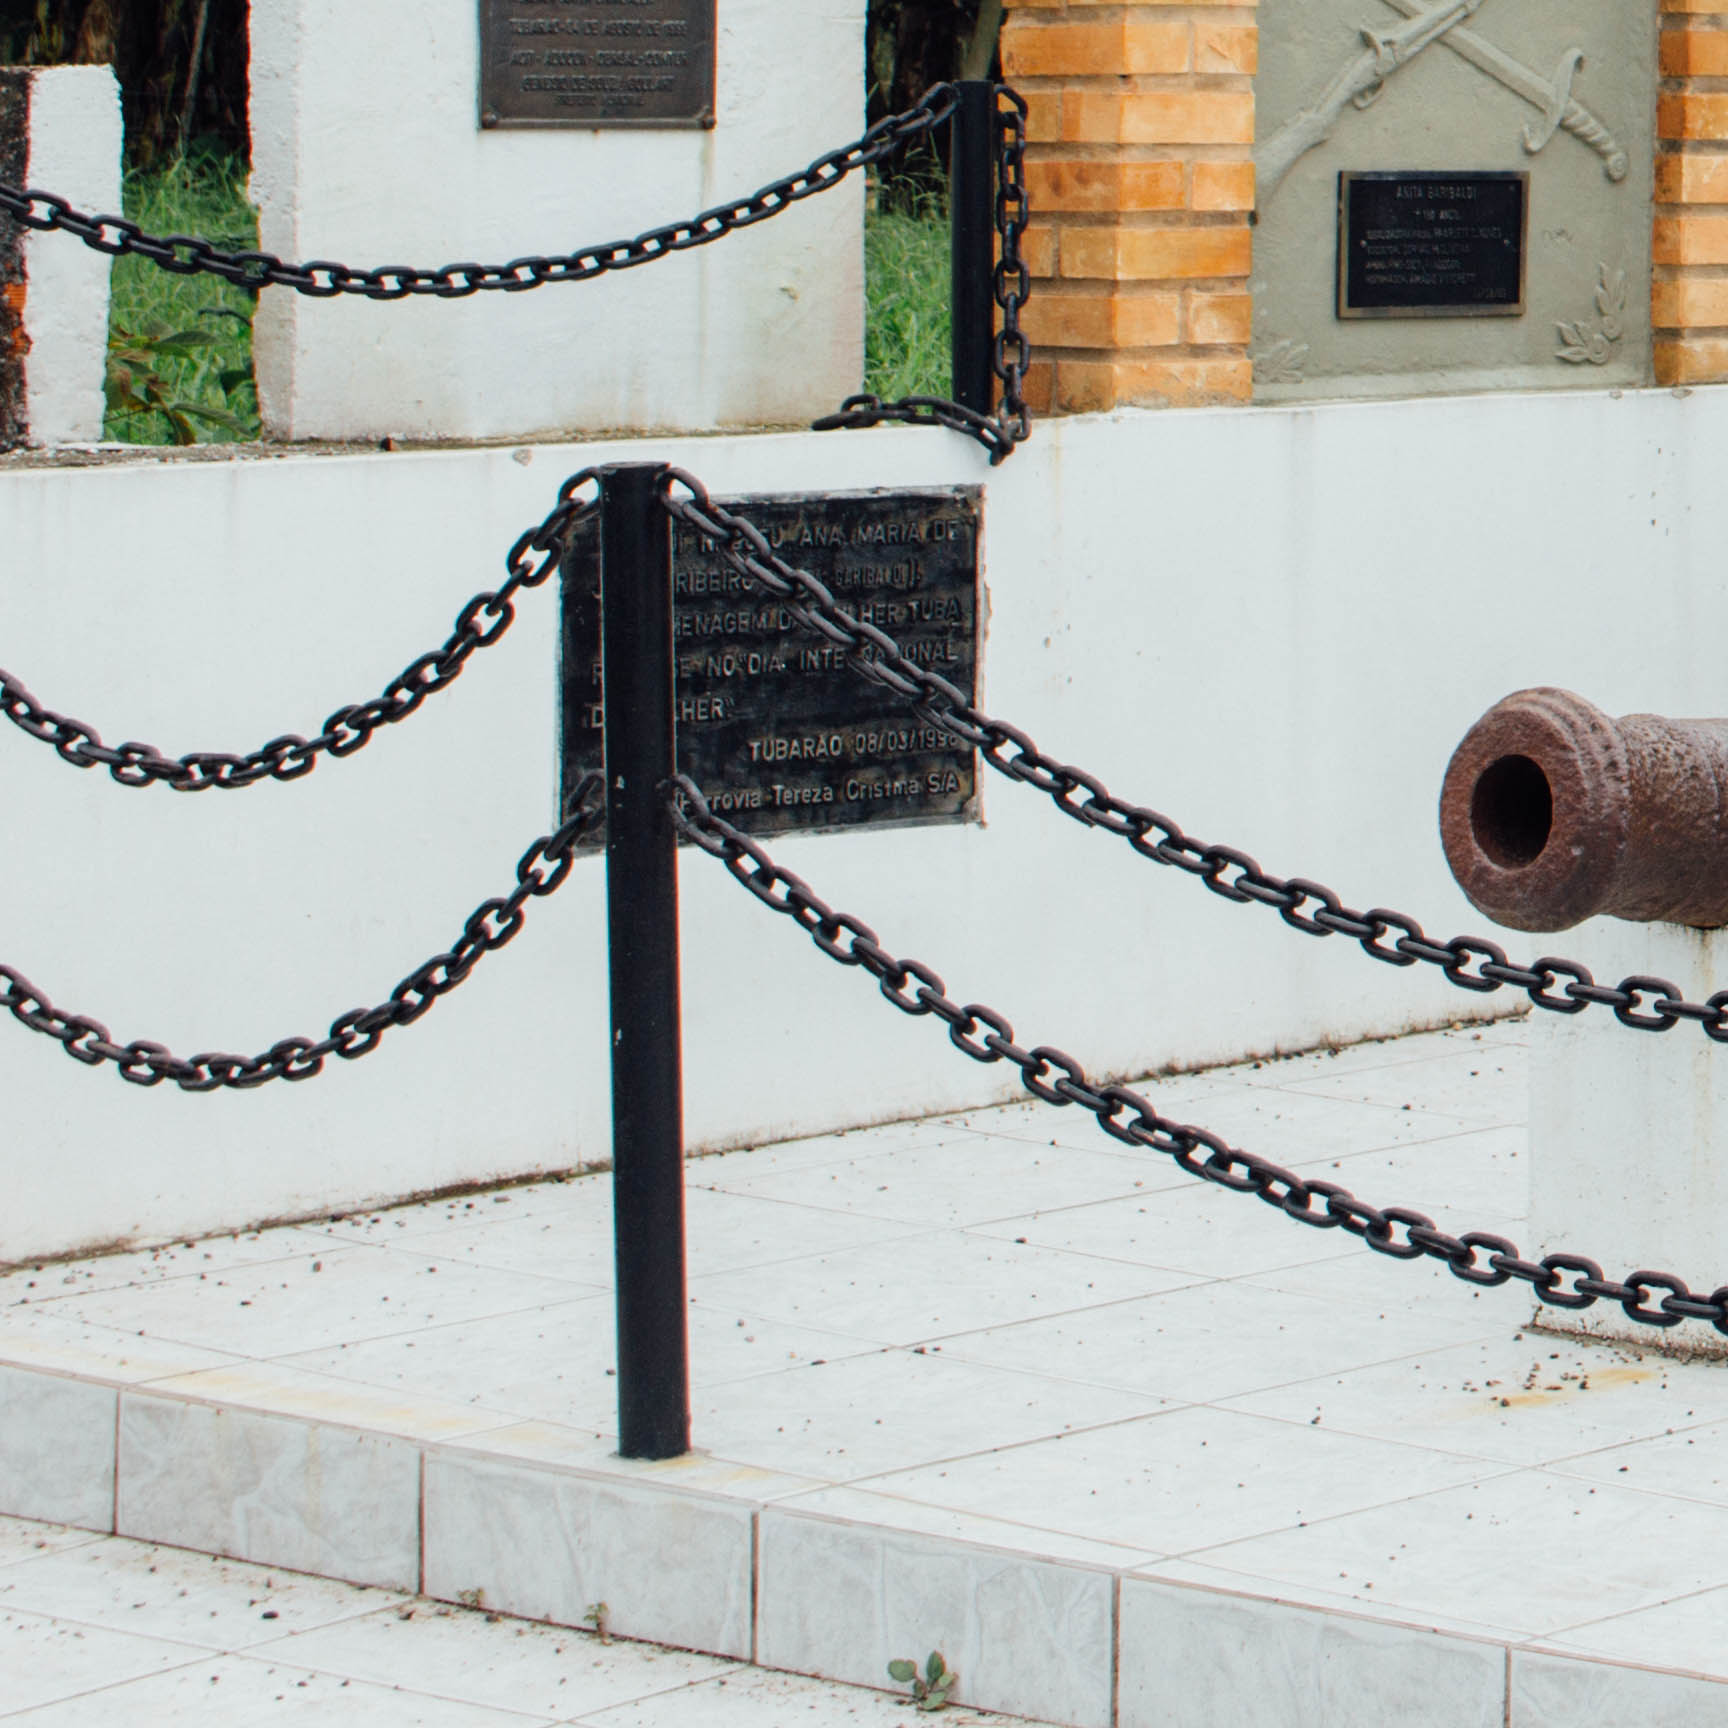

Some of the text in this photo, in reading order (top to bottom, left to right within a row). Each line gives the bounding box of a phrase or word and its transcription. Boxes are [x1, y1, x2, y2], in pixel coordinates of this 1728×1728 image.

[857, 522, 921, 545] MARIA
[933, 519, 959, 542] DE
[770, 783, 834, 806] Tereza
[927, 771, 961, 794] S/A
